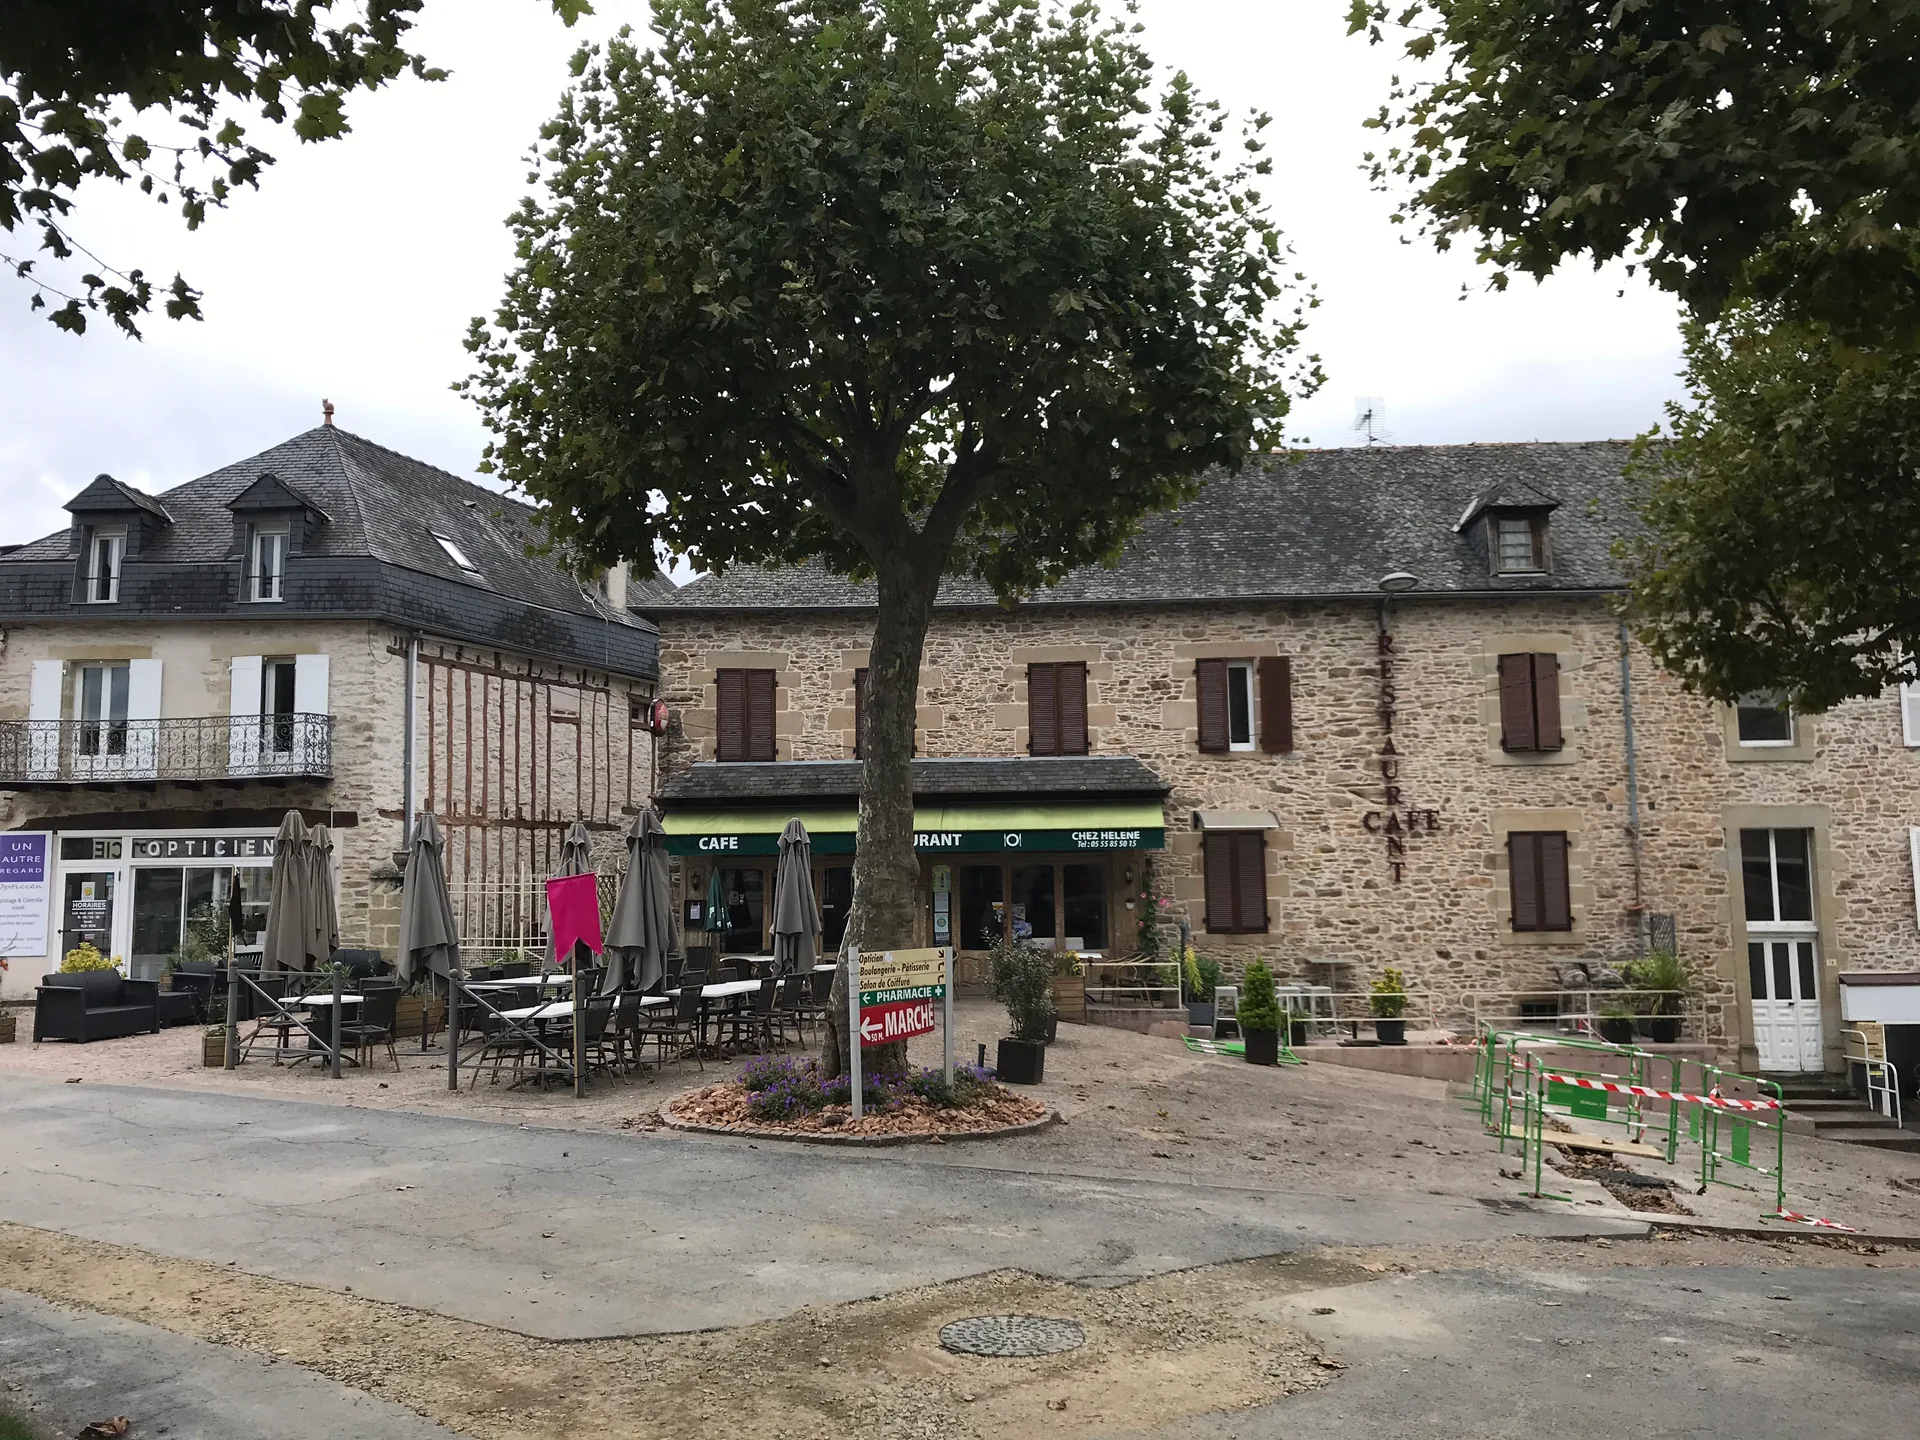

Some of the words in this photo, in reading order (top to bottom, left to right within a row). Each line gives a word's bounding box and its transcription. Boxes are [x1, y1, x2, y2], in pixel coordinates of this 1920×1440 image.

[1377, 635, 1406, 882] RESTAURANT
[1072, 831, 1099, 840] CHEZ
[1101, 831, 1140, 839] HELENE
[147, 840, 274, 856] OPTICIEN
[699, 837, 738, 849] CAFE
[859, 954, 883, 965] Opticien
[860, 964, 896, 976] Boulangerie
[902, 962, 930, 972] Pâtisserie
[860, 980, 876, 990] Salon
[878, 979, 885, 988] de
[887, 977, 910, 987] Coiffure
[876, 987, 932, 1002] PHARMACIE
[885, 998, 934, 1037] MARCHÉ
[871, 1033, 878, 1042] 50
